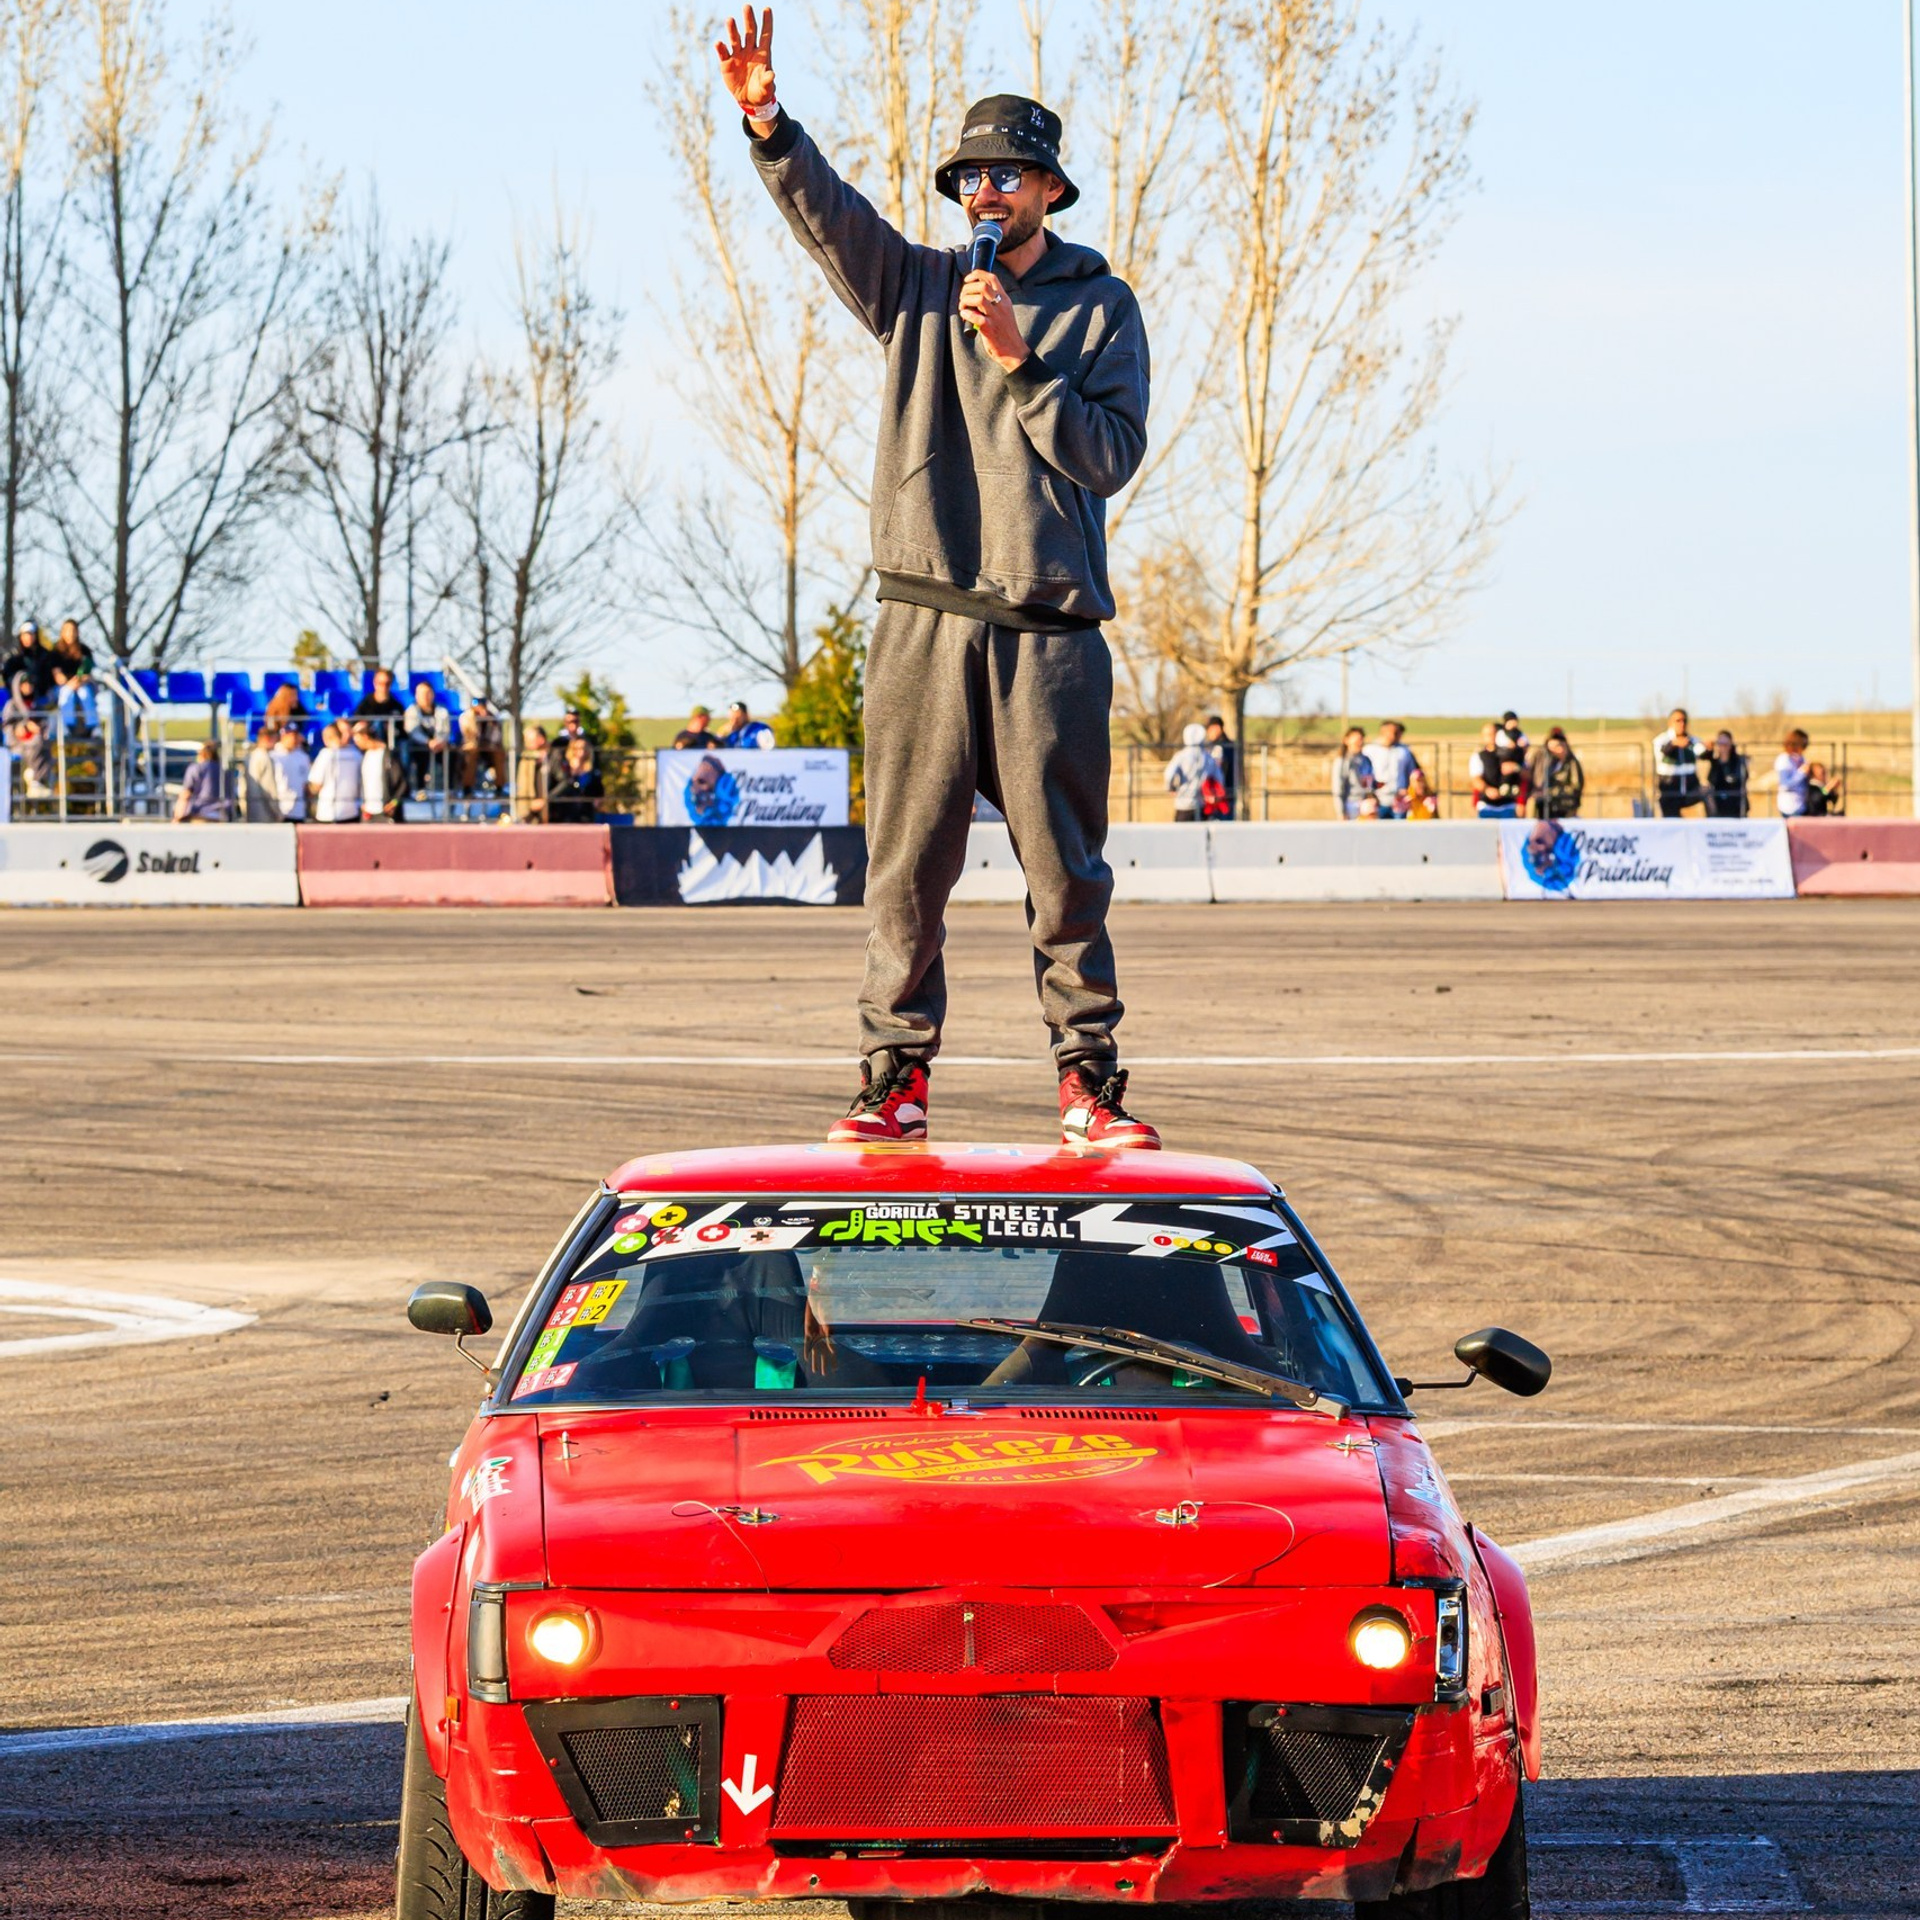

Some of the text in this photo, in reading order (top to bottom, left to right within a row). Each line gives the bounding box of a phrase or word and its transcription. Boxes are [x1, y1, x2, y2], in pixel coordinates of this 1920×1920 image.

[738, 797, 827, 826] Painting
[136, 850, 200, 873] Sokol
[1578, 858, 1674, 887] Painting
[866, 1204, 1059, 1221] GORILLA STREET
[987, 1219, 1075, 1239] LEGAL
[576, 1285, 590, 1303] 1
[607, 1283, 619, 1300] 1
[560, 1306, 578, 1326] 2
[590, 1304, 607, 1321] 2
[530, 1372, 543, 1391] 1
[553, 1365, 572, 1385] 2
